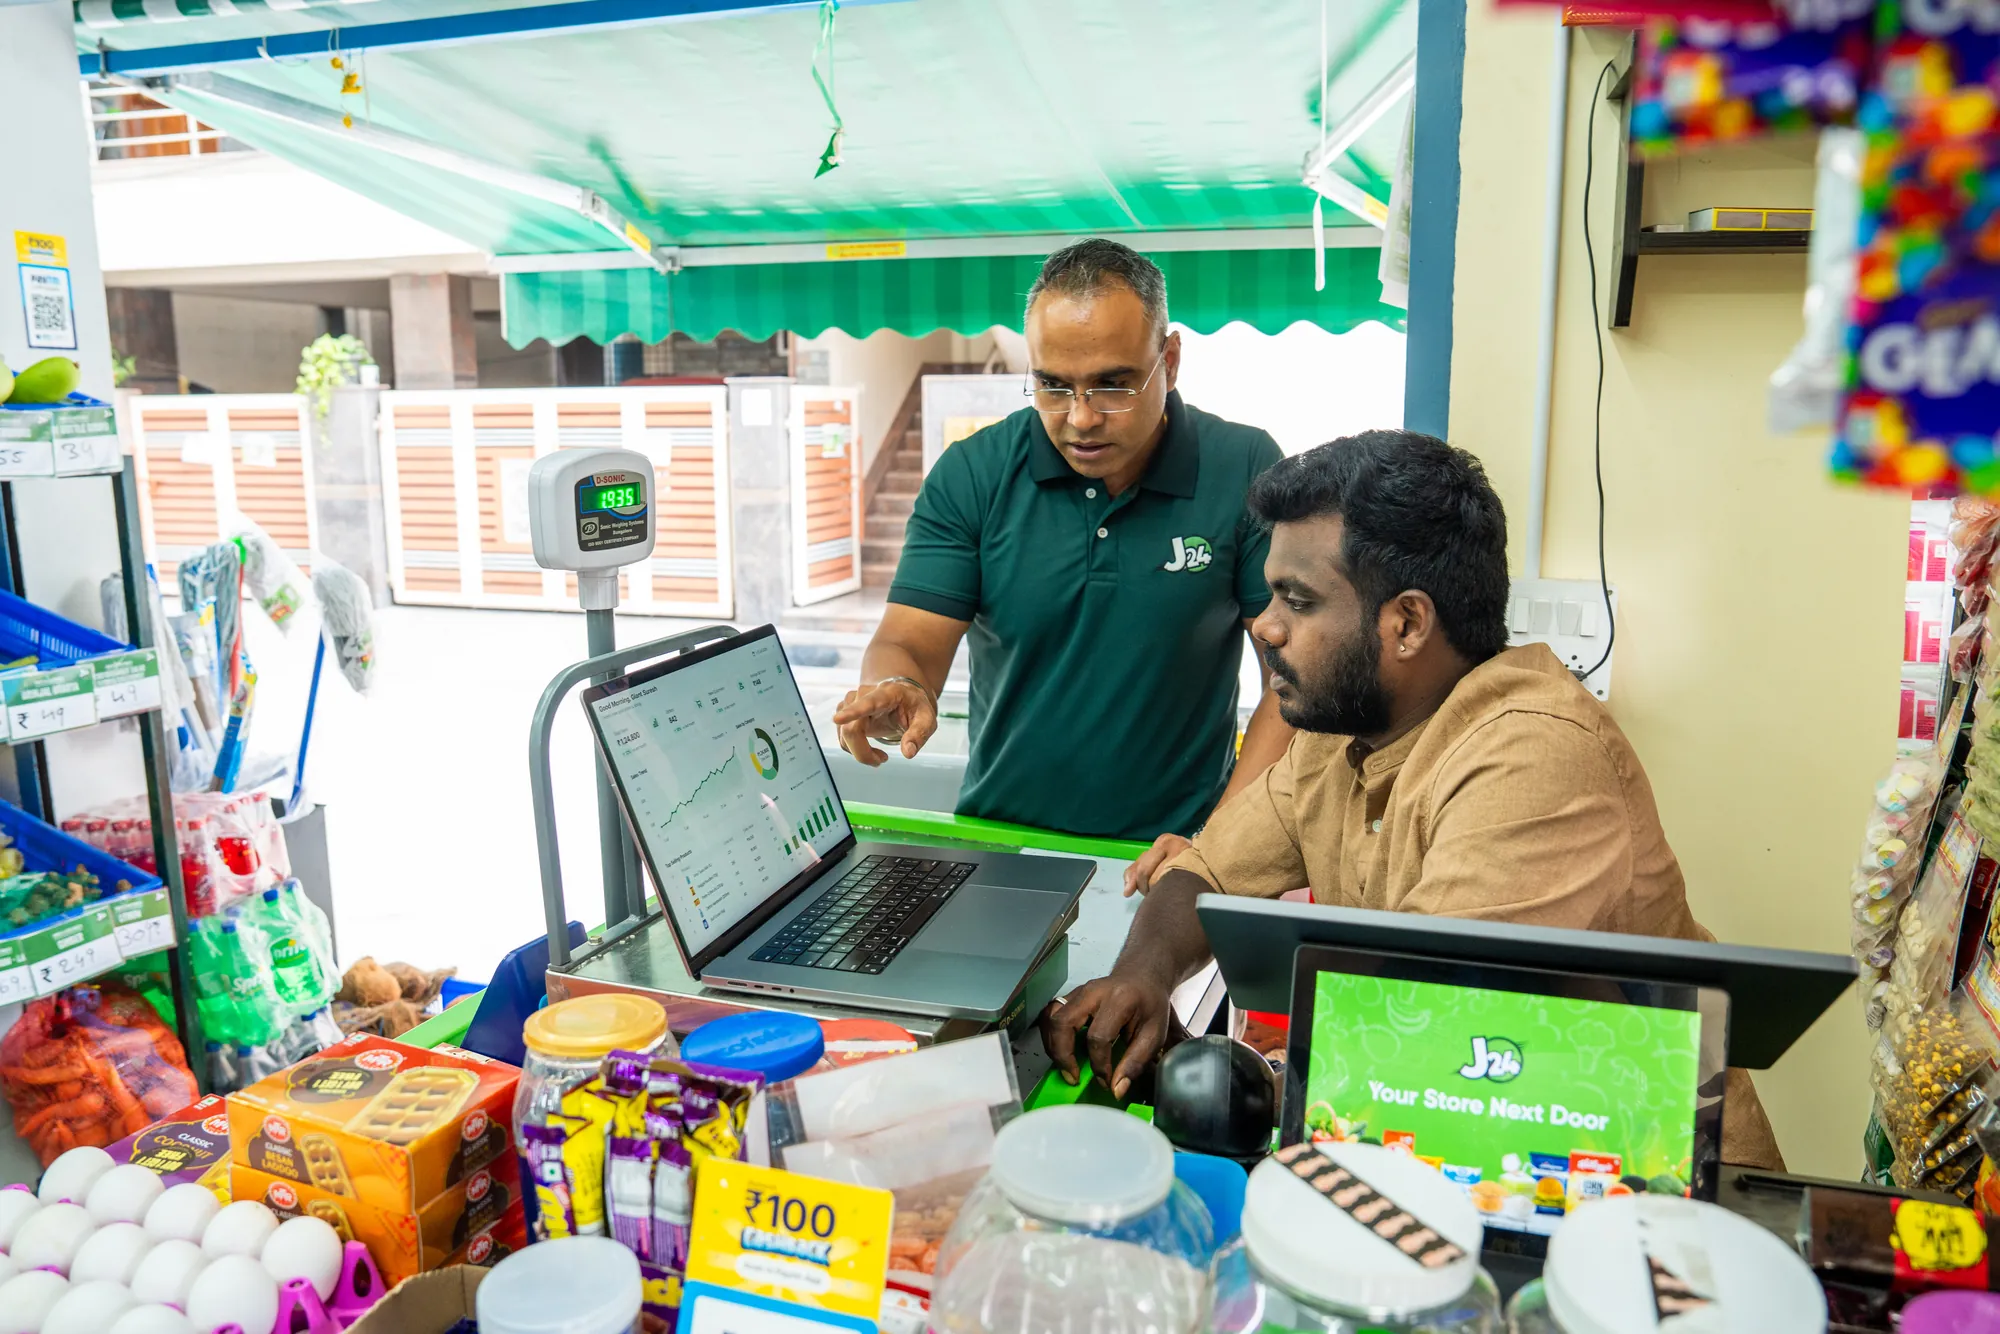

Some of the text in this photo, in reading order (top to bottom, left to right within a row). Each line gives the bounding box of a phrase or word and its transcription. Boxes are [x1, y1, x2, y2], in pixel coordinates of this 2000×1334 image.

[596, 474, 625, 484] D-SONIC
[1163, 536, 1212, 572] J24
[598, 702, 612, 712] Good
[1459, 1035, 1522, 1080] J24
[1368, 1080, 1609, 1132] Your Store Next Door
[178, 1132, 214, 1149] CLASSIC
[745, 1188, 835, 1238] ₹100
